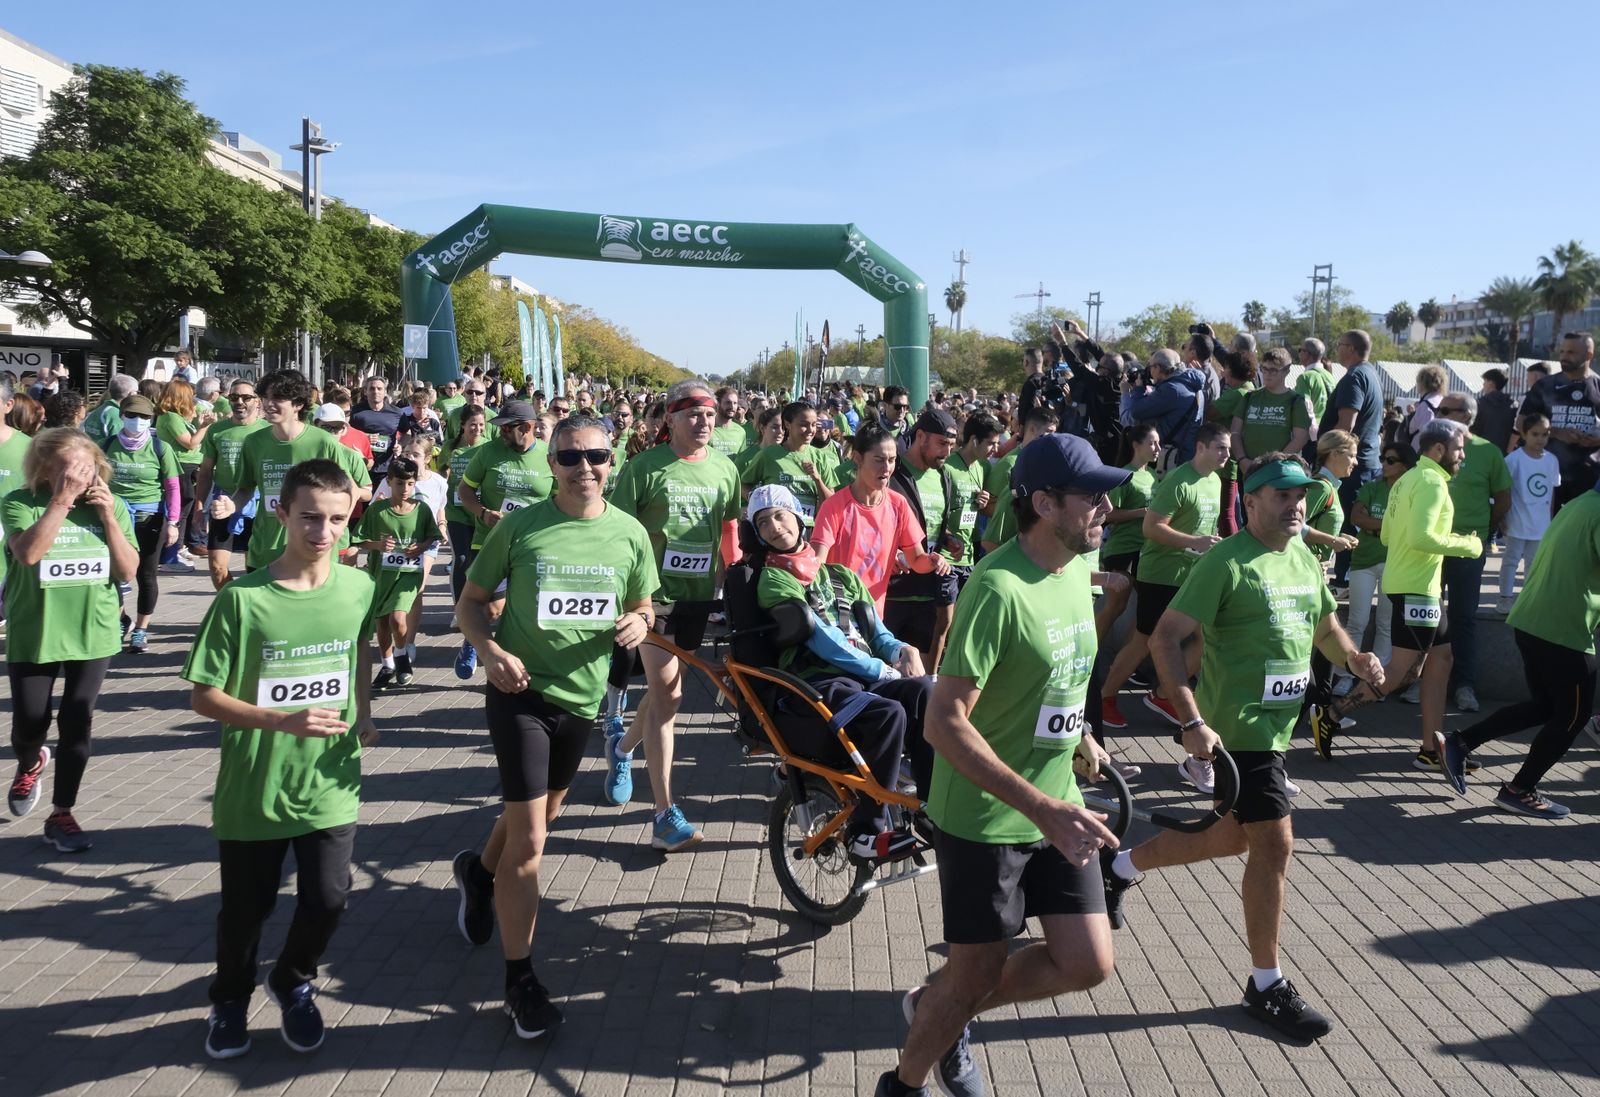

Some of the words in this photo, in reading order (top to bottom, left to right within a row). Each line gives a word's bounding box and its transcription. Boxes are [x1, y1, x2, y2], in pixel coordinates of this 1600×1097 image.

[651, 221, 729, 245] aecc
[438, 223, 490, 265] aecc
[652, 247, 673, 258] en
[678, 246, 744, 262] marcha
[860, 257, 910, 293] aecc
[410, 329, 421, 343] P
[263, 463, 273, 471] En
[510, 468, 539, 476] marcha
[668, 484, 681, 492] En
[684, 485, 718, 495] marcha
[669, 495, 699, 503] contra
[669, 504, 677, 512] el
[680, 504, 710, 514] cáncer
[54, 535, 79, 543] ntra
[50, 562, 103, 577] 0594
[536, 562, 556, 575] En
[561, 564, 615, 576] marcha
[670, 556, 709, 570] 0277
[1264, 586, 1280, 597] En
[1280, 584, 1316, 595] marcha
[548, 598, 609, 615] 0287
[1268, 598, 1297, 610] contra
[1270, 611, 1280, 623] el
[1282, 610, 1308, 622] cáncer
[1410, 608, 1440, 619] 0060
[1047, 628, 1063, 644] En
[262, 648, 285, 661] En
[291, 639, 352, 657] marcha
[1051, 663, 1062, 678] el
[271, 678, 341, 702] 0288
